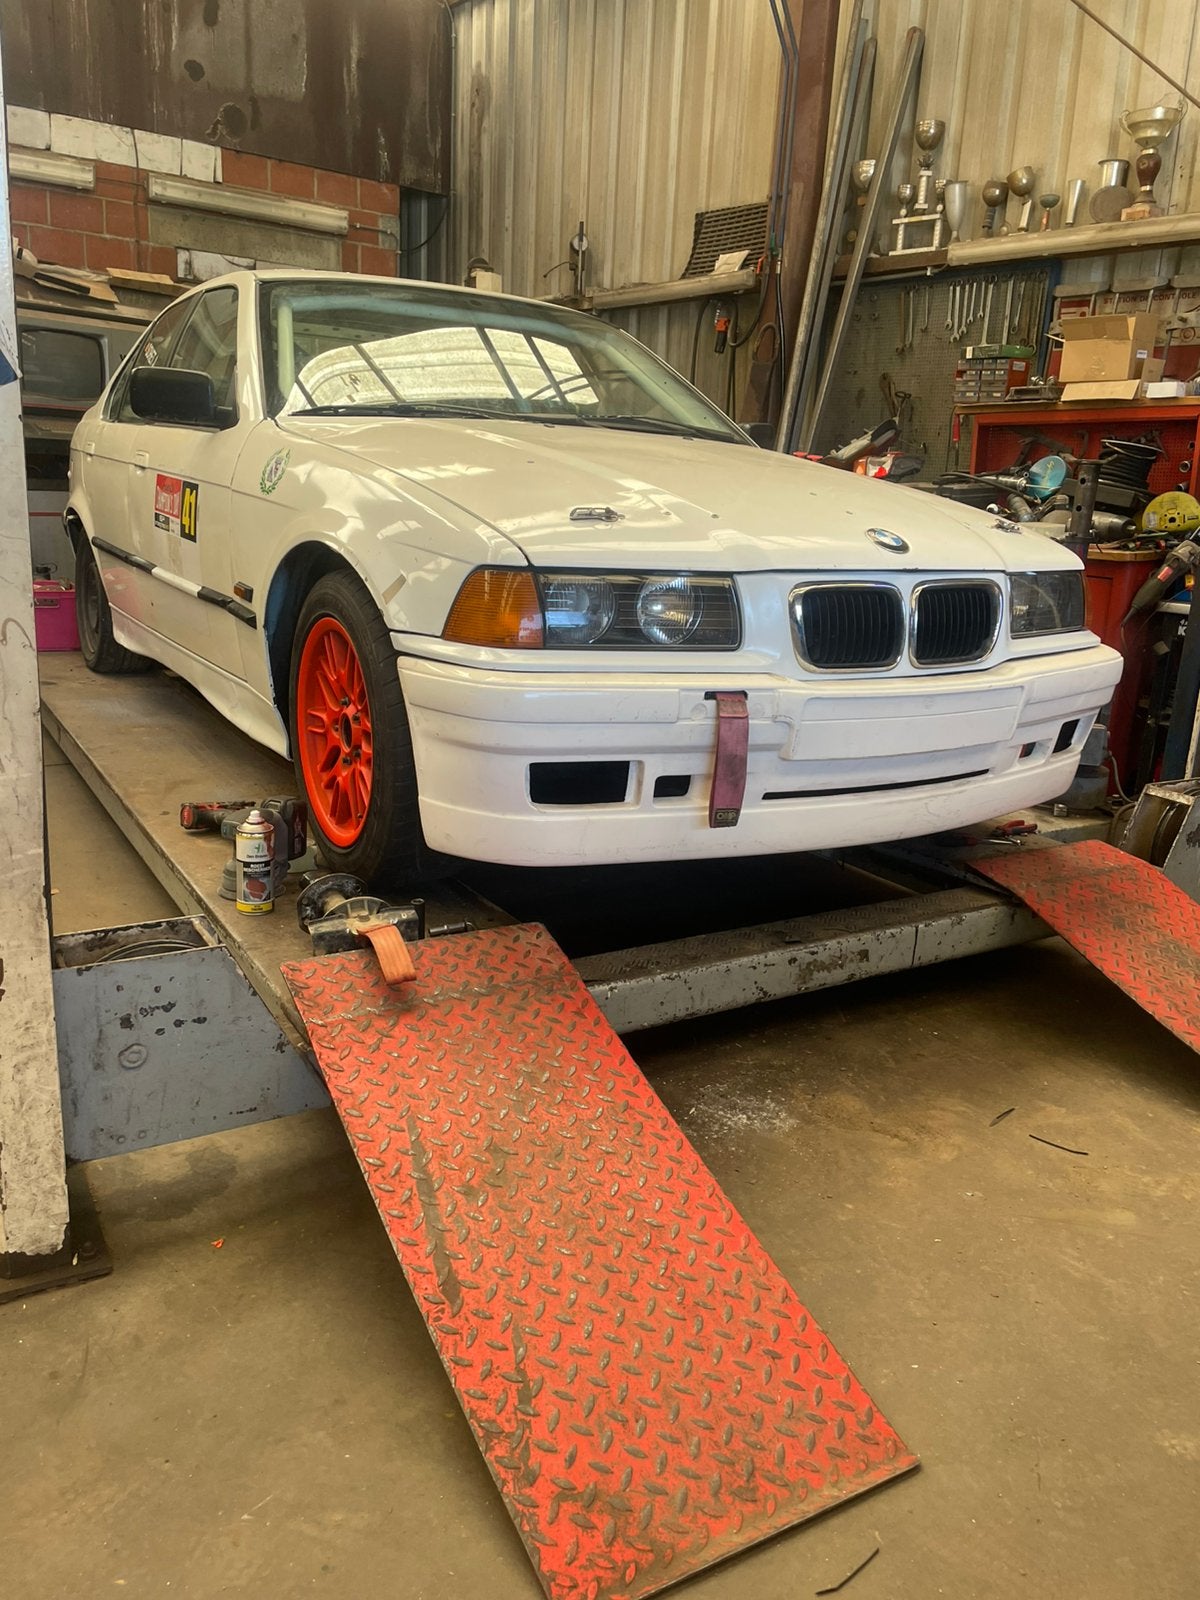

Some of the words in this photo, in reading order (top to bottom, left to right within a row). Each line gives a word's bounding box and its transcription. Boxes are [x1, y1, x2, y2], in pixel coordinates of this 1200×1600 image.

[1103, 296, 1137, 304] STTION
[1153, 292, 1196, 302] CONTOLE
[182, 488, 196, 536] 41
